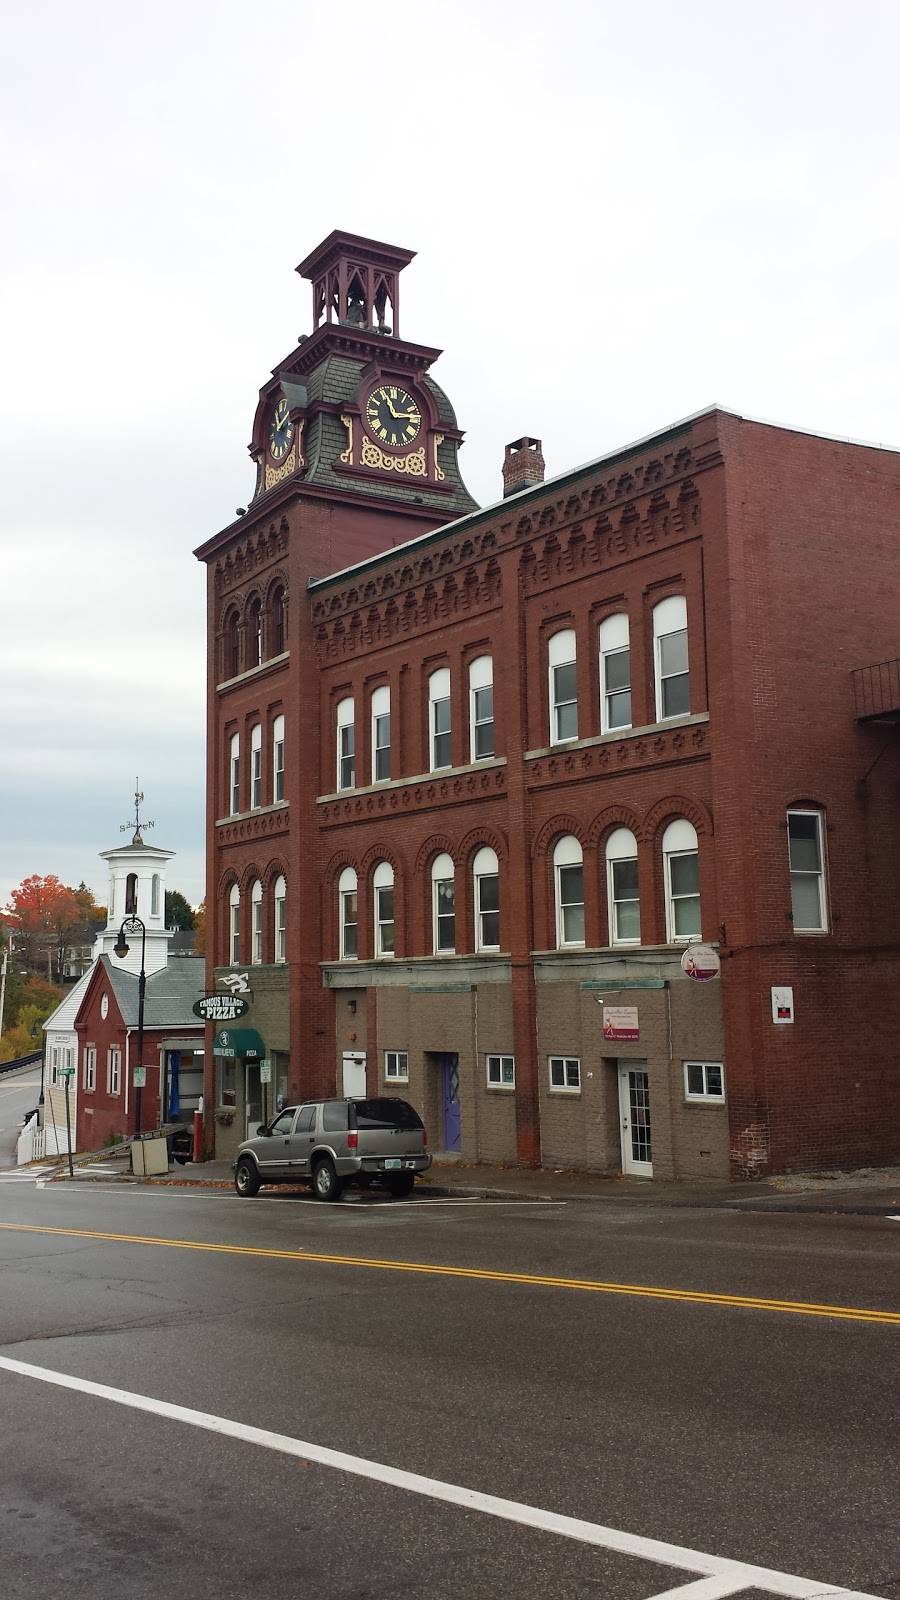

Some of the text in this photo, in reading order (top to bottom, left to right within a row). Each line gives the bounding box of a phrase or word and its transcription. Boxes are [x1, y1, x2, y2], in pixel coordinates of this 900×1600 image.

[200, 997, 243, 1007] FAMOUS VILLAGE
[207, 1007, 236, 1019] PIZZA
